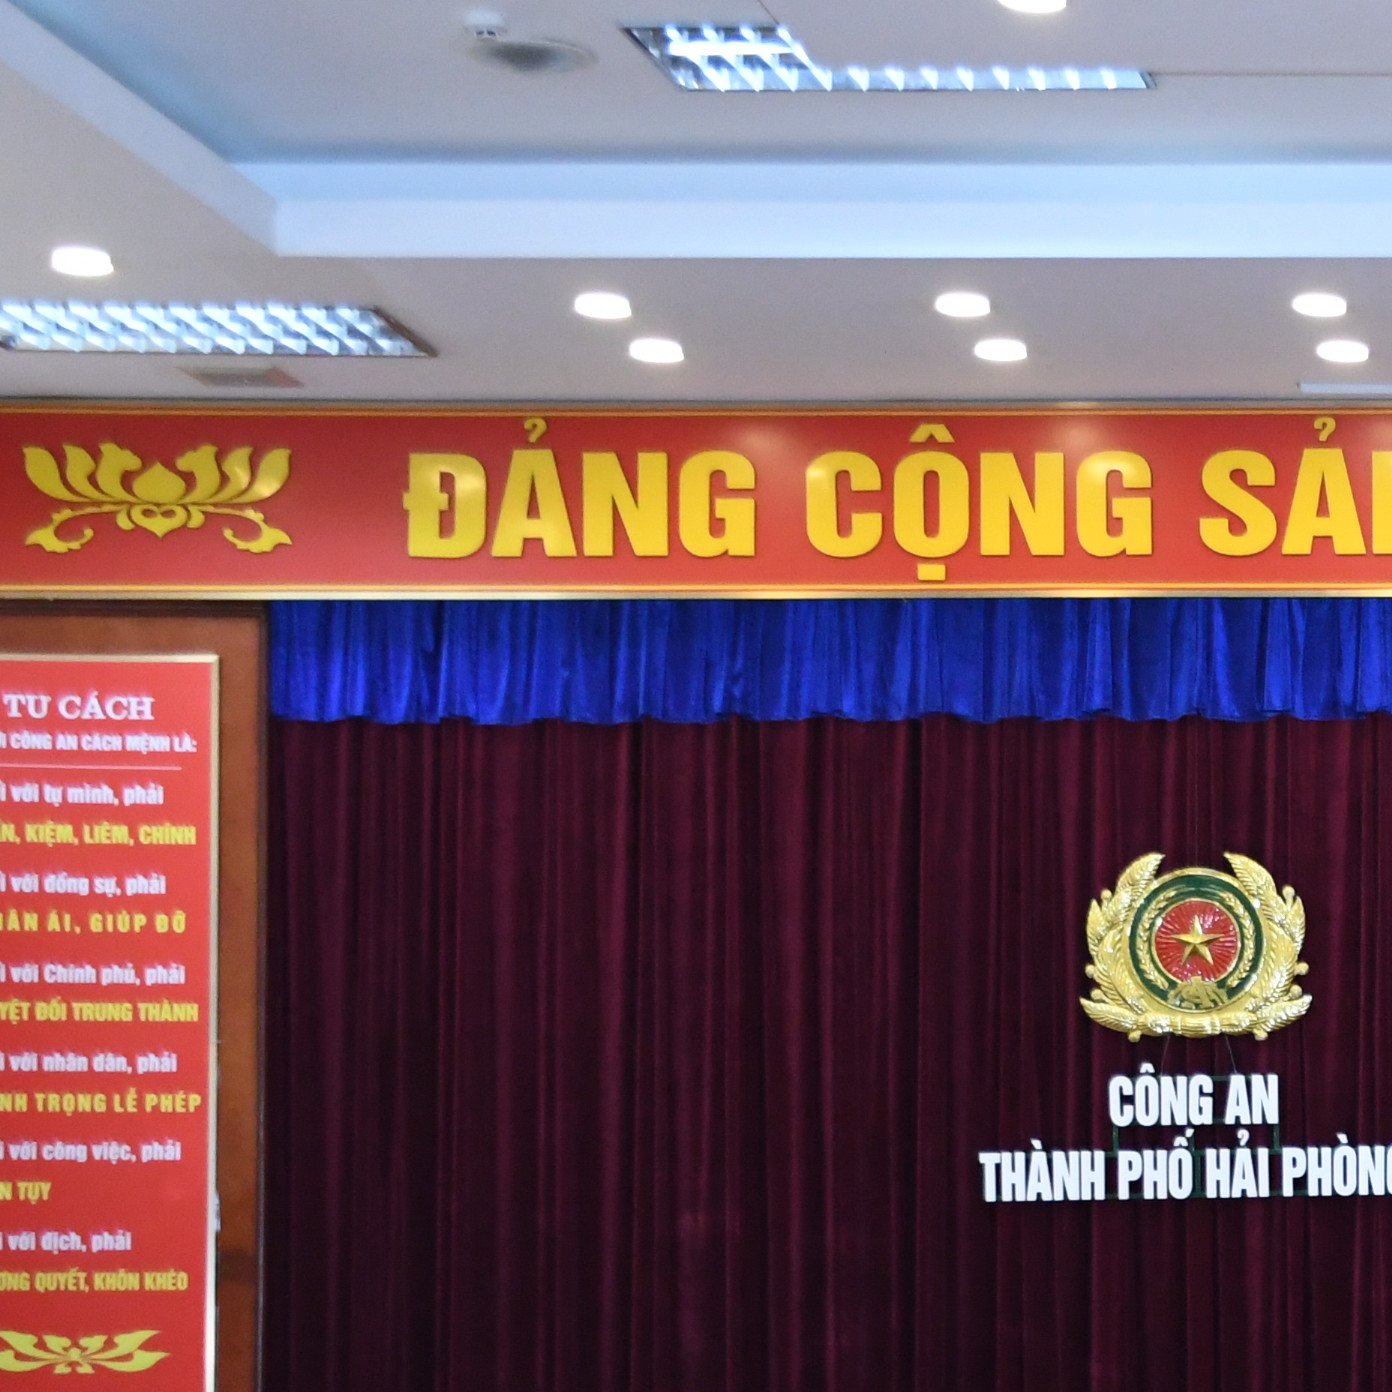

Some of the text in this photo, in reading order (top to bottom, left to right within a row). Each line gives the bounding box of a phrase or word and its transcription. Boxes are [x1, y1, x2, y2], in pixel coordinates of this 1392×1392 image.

[403, 419, 760, 558] ĐẢNG
[805, 425, 1156, 584] CỘNG
[58, 691, 154, 720] CÁCH
[10, 731, 52, 749] CÔNG
[56, 734, 77, 750] AN
[81, 733, 122, 751] CÁCH
[125, 733, 170, 754] MỆNH
[25, 820, 78, 847] KIỆM,
[83, 821, 134, 845] LIÊM,
[139, 823, 196, 844] CHÍNH
[35, 997, 67, 1021] ĐỐI
[72, 1003, 132, 1021] TRUNG
[138, 1000, 198, 1021] THÀNH
[35, 1093, 106, 1115] TRỌNG
[114, 1088, 137, 1112] LỄ
[145, 1091, 201, 1112] PHÉP
[1109, 1063, 1278, 1127] CÔNG AN
[979, 1139, 1105, 1202] THÀNH
[1117, 1128, 1194, 1200] PHỐ
[1205, 1129, 1269, 1198] HẢI
